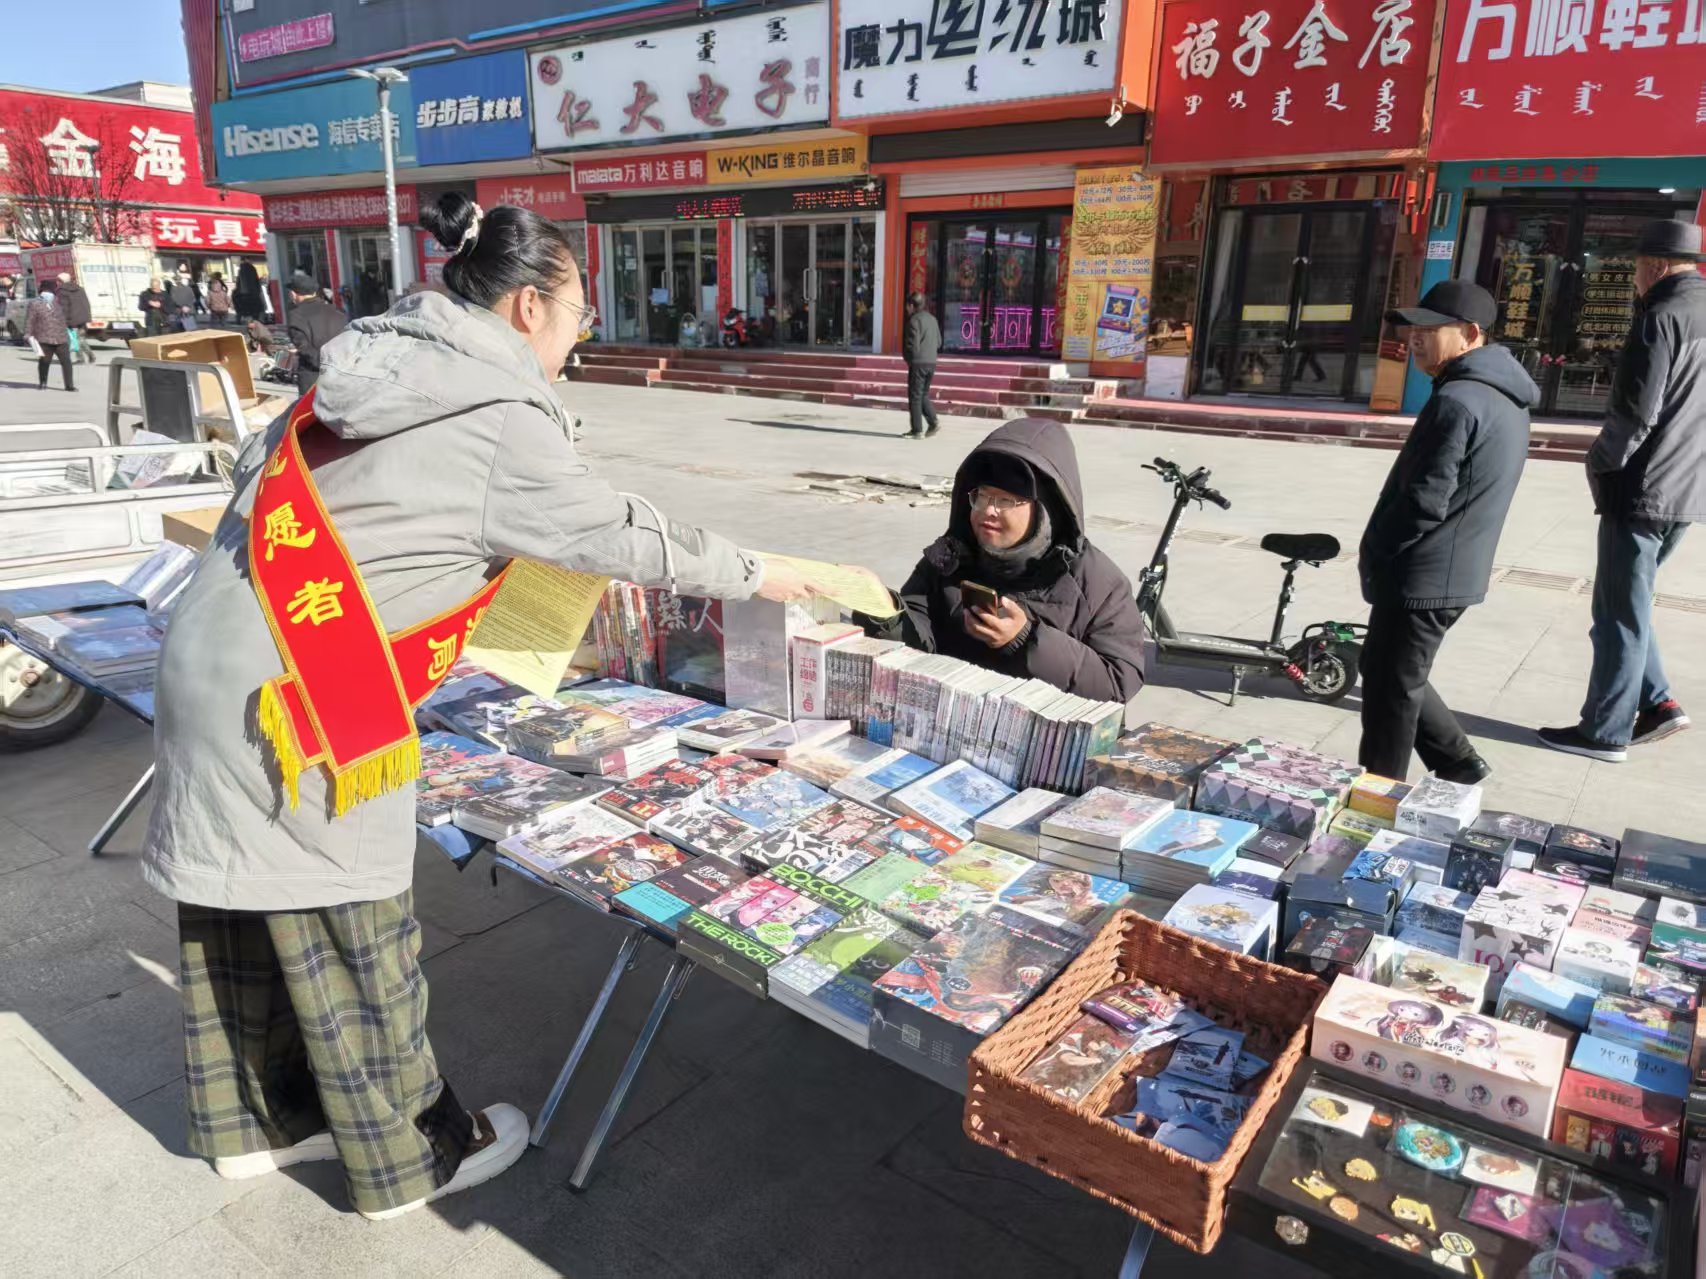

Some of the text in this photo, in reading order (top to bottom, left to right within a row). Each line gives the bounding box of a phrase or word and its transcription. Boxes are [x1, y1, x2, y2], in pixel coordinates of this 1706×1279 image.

[1172, 0, 1414, 80] 福子金店
[557, 57, 796, 137] 仁大电子
[804, 55, 821, 105] 商行
[416, 94, 480, 129] 步步高
[223, 123, 319, 158] Hisense
[783, 147, 856, 168] 维尔晶音响
[577, 157, 704, 185] malata 万利达音响
[155, 216, 267, 247] 玩具
[1504, 263, 1536, 338] 万顺鞋城
[772, 863, 869, 908] BOCCHI
[685, 913, 778, 966] THE ROCK!
